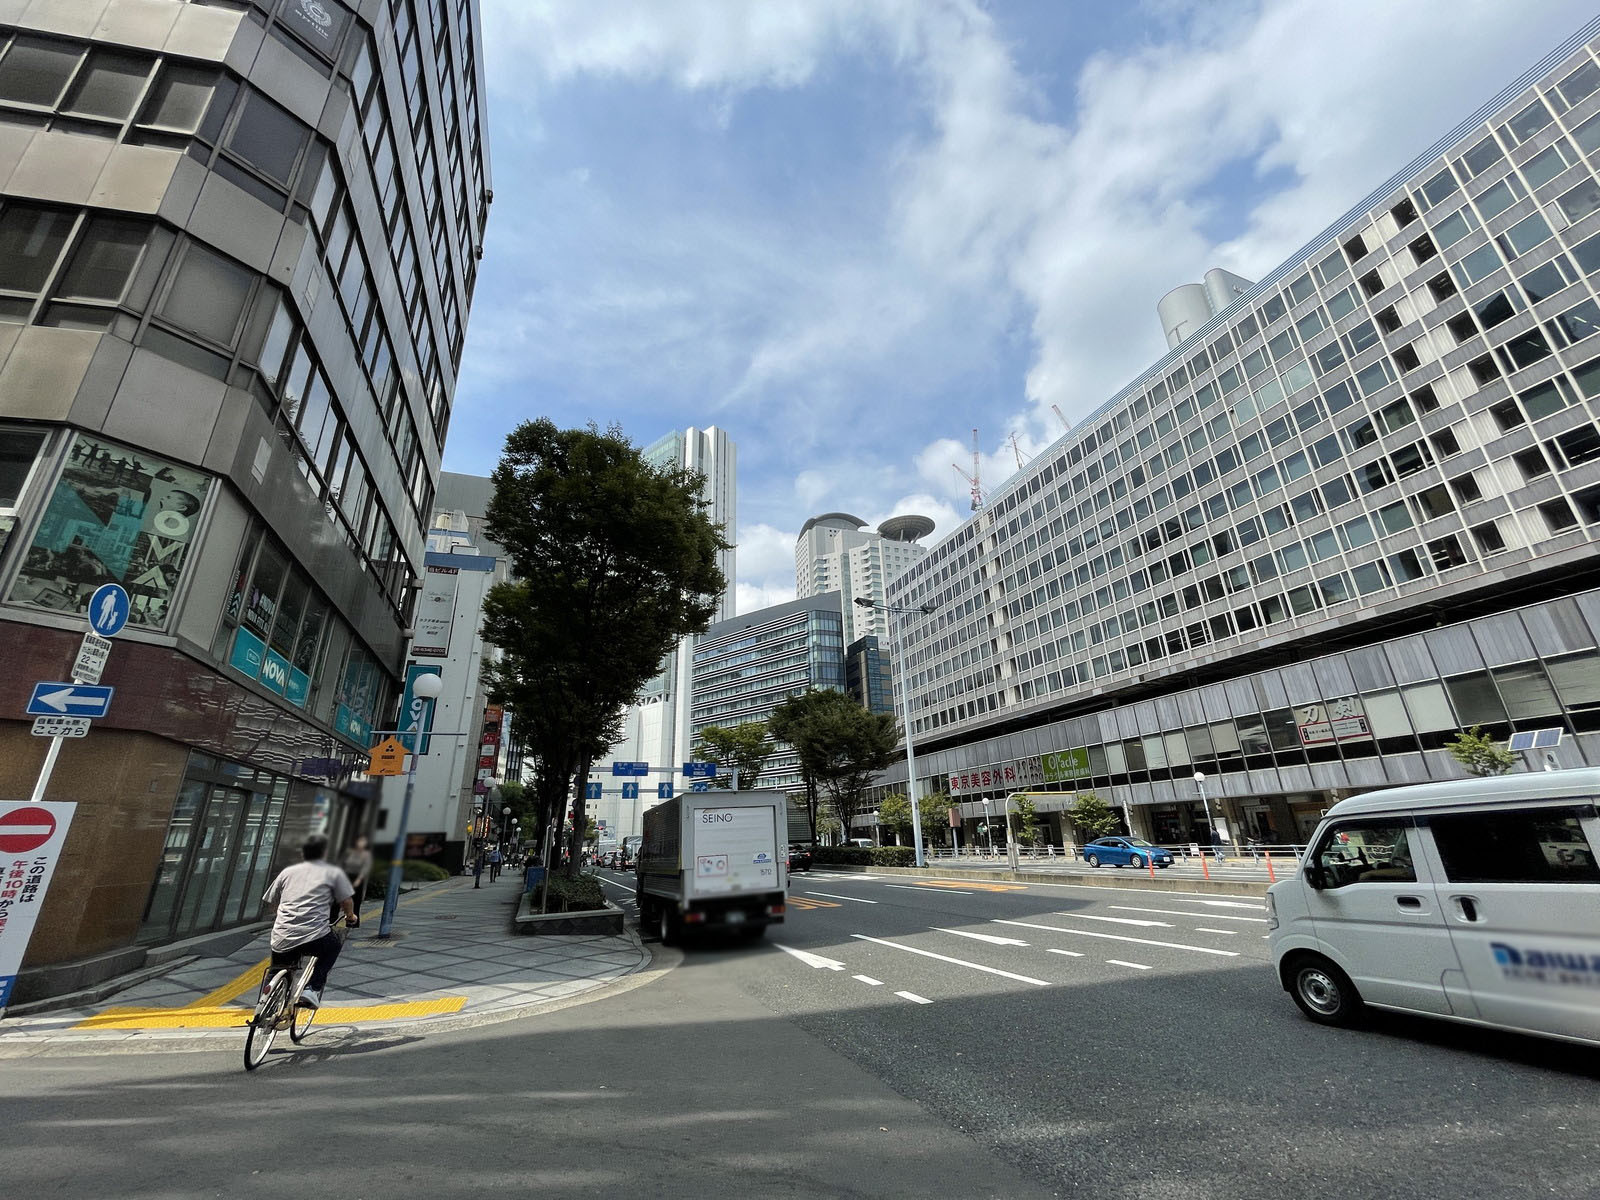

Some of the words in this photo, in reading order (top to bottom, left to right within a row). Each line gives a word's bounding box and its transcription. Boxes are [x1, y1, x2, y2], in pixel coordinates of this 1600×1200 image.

[262, 658, 286, 688] NOVA
[34, 726, 85, 736] ここから
[1048, 754, 1079, 769] Oracle
[950, 765, 1017, 791] 東京美容外科
[702, 813, 733, 824] SEINO
[19, 856, 48, 903] この道路は
